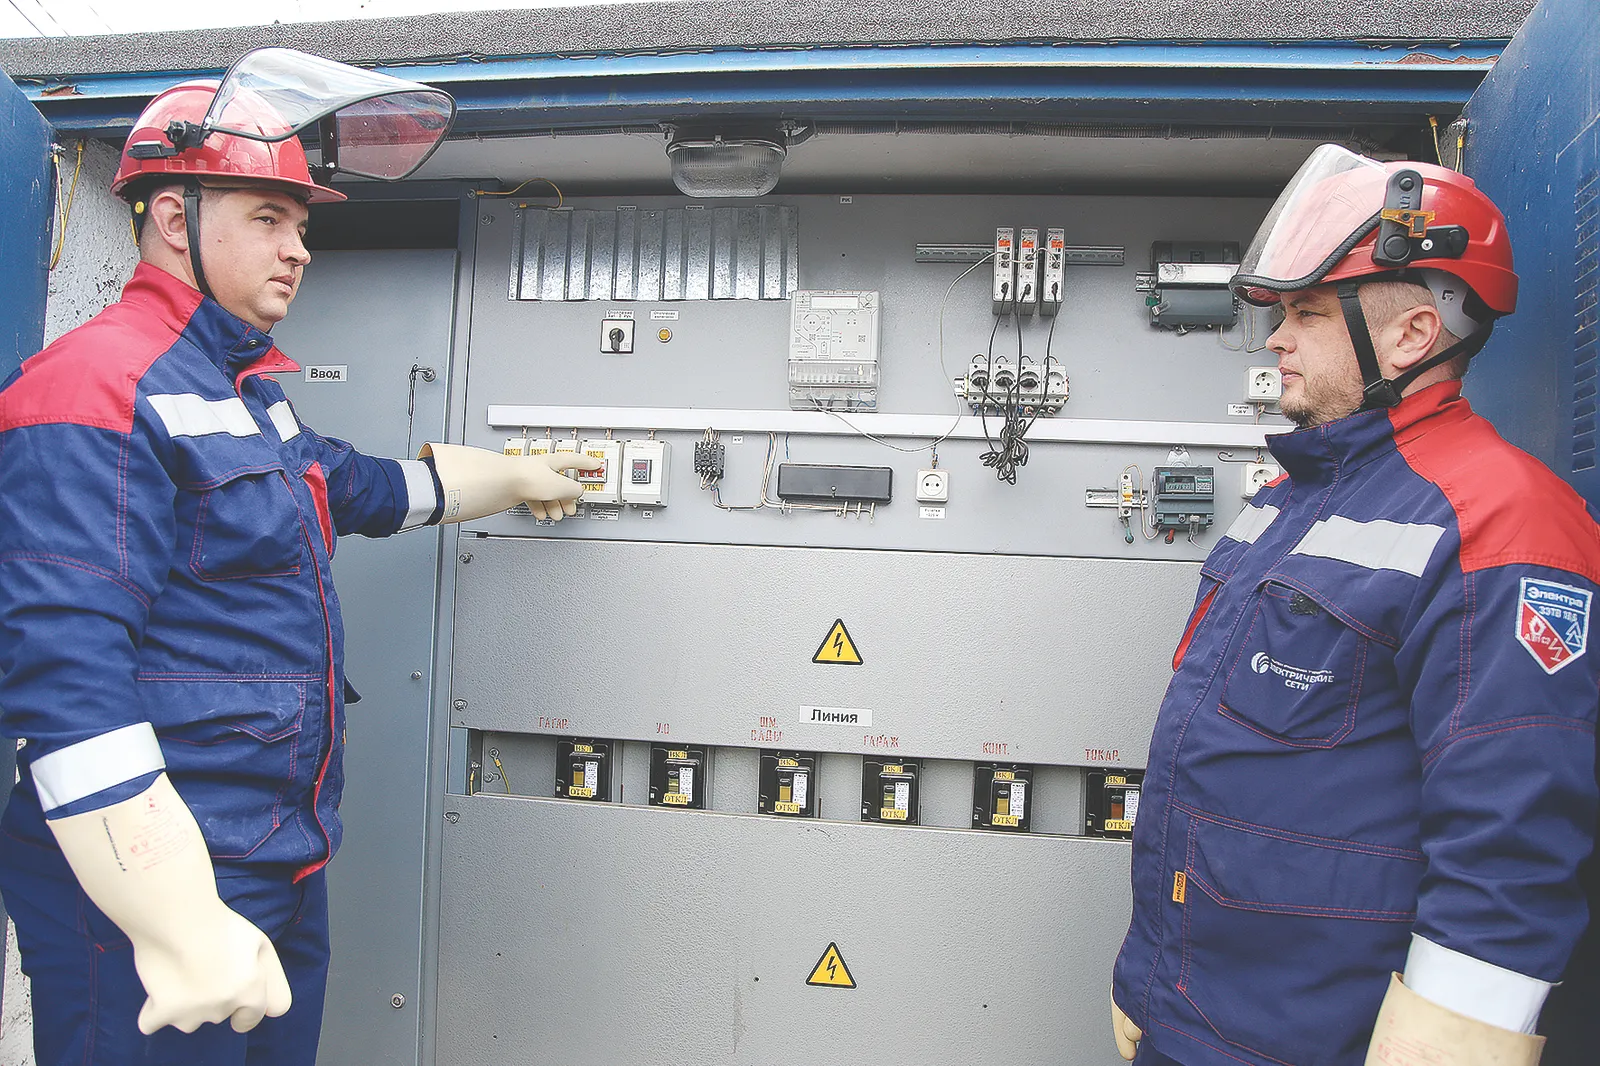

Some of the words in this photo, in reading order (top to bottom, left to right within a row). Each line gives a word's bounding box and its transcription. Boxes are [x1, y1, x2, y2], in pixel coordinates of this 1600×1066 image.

[311, 368, 341, 381] Ввод
[1285, 680, 1309, 691] СЕТИ
[811, 709, 858, 723] Линия
[863, 735, 901, 748] ГАРАЖ
[576, 744, 593, 753] ВКЛ
[982, 742, 1010, 755] КОНТ.
[669, 751, 687, 759] ВКЛ
[1085, 748, 1121, 762] ТОКАР.
[884, 765, 903, 773] ВКЛ
[995, 771, 1014, 780] ВКЛ
[1107, 776, 1126, 784] ВКЛ
[570, 788, 592, 797] ОТКЛ
[665, 795, 687, 804] ОТКЛ
[776, 803, 800, 812] ОТКЛ
[882, 810, 906, 819] ОТКЛ
[993, 816, 1018, 826] ОТКЛ
[1106, 820, 1131, 830] ОТКЛ
